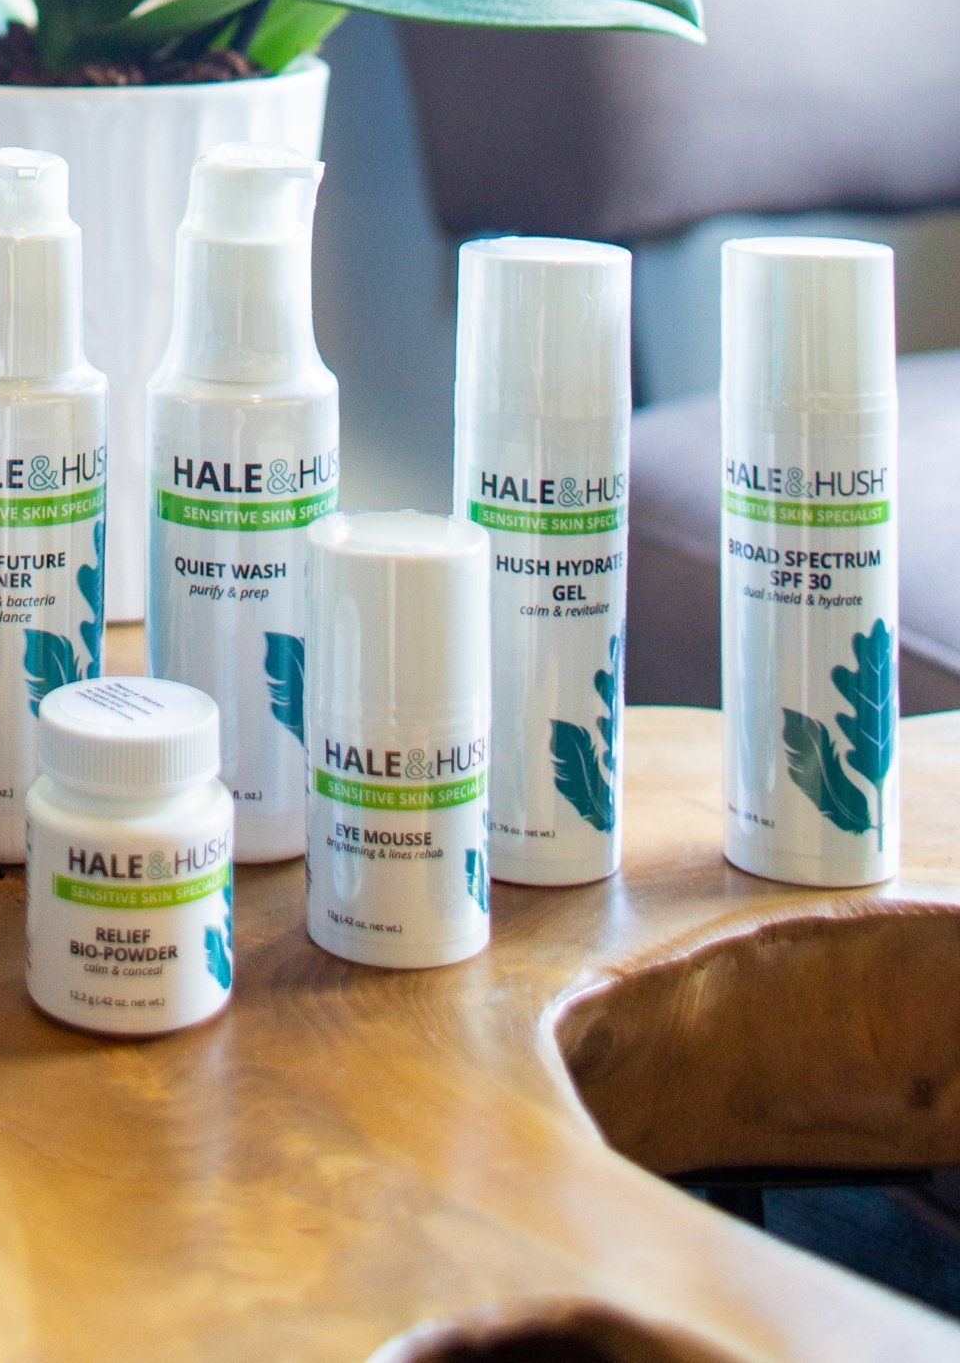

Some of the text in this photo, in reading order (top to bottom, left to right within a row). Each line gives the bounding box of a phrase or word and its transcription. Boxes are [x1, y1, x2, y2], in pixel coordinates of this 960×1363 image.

[22, 505, 58, 520] SKIN
[183, 505, 258, 524] SENSITIVE
[262, 509, 296, 524] SKIN
[482, 509, 549, 530] SENSITIVE
[551, 517, 584, 530] SKIN
[779, 507, 813, 522] SKIN
[818, 507, 883, 523] SPECIALIST
[728, 537, 881, 570] BROAD SPECTRUM
[174, 556, 286, 579] QUIET WASH
[496, 554, 550, 576] HUSH
[770, 570, 832, 590] SPF 30
[7, 594, 56, 608] bacteria
[189, 584, 269, 601] purify & prep
[552, 584, 587, 602] GEL
[743, 583, 863, 610] dual shield & hydrate
[520, 602, 610, 617] calm & revitalize
[328, 780, 396, 805] SENSITIVE
[399, 791, 434, 805] SKIN
[335, 822, 432, 847] EYE MOUSSE
[326, 836, 444, 860] brightening & lines rehab
[70, 873, 226, 904] SENSITIVE SKIN SPECIALIST
[95, 926, 151, 944] RELIEF
[70, 939, 178, 962] BIO-POWDER
[83, 963, 163, 976] calm & conceal
[131, 996, 147, 1007] net
